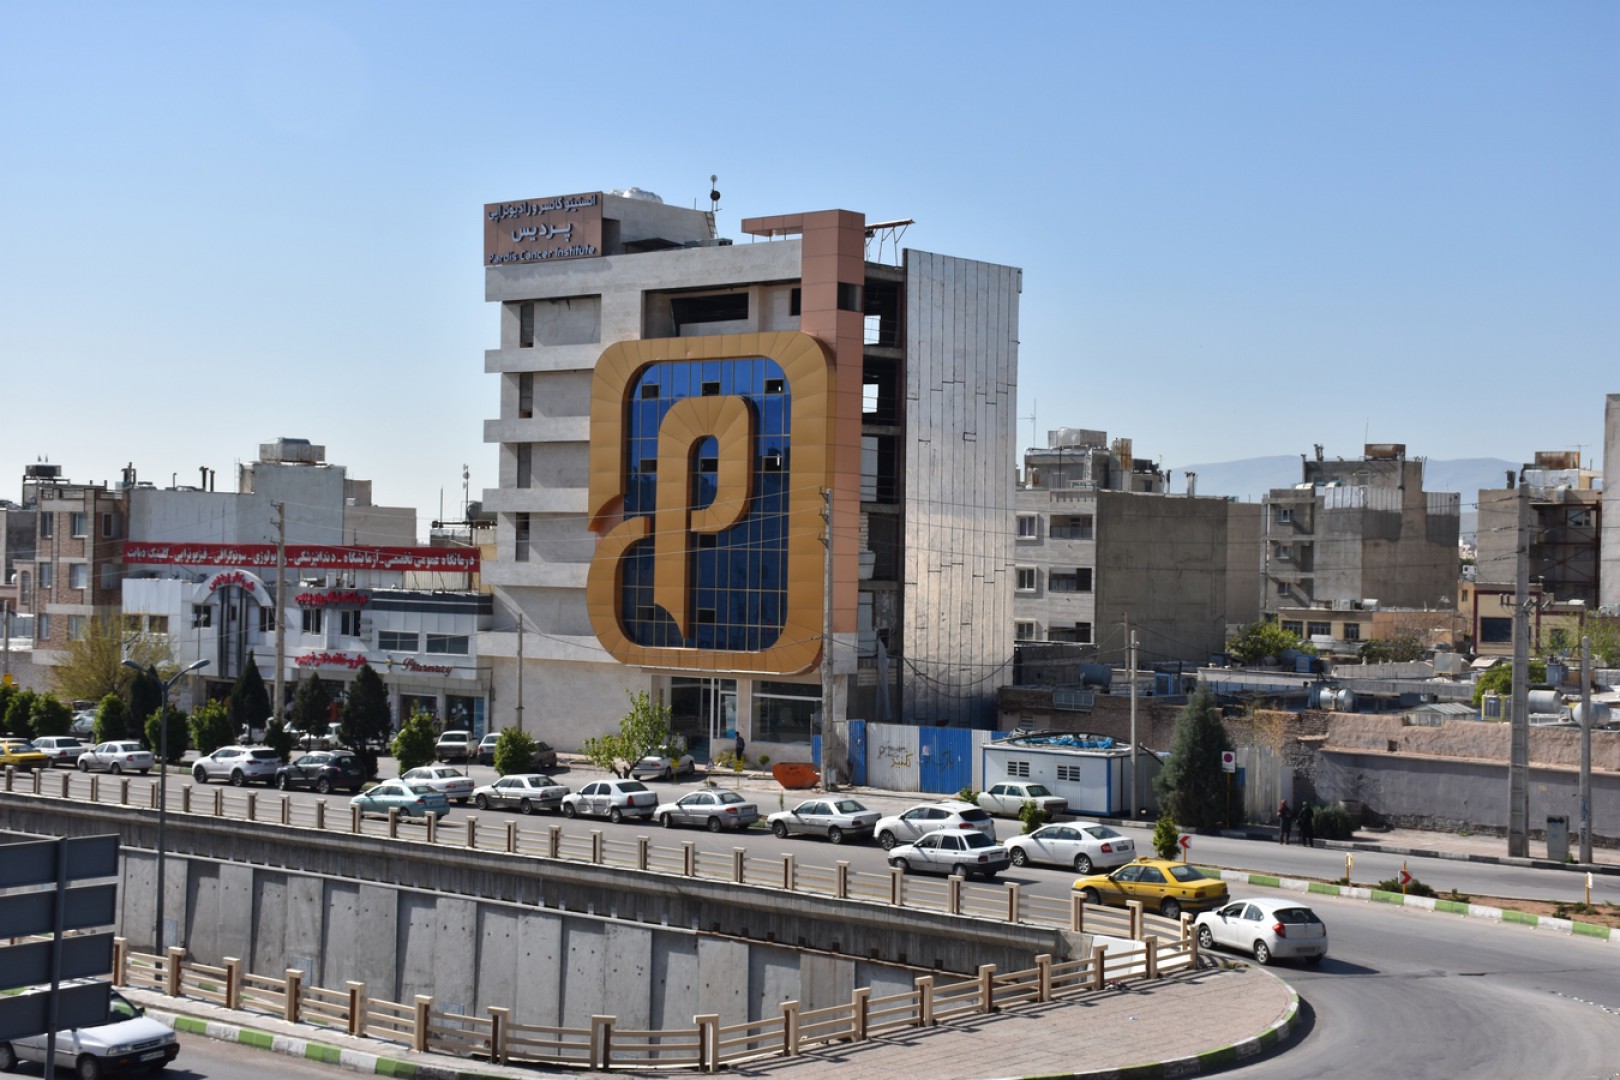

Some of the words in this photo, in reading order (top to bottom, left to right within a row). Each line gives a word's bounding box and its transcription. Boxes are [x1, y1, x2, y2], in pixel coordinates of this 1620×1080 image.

[488, 201, 532, 223] رادیوتراپی
[539, 197, 564, 214] کانسر
[512, 222, 573, 242] پردیس
[489, 251, 519, 263] Pardis
[521, 249, 554, 260] Cancer
[556, 243, 596, 257] Institute
[214, 548, 247, 564] سونوگرافی
[343, 549, 379, 568] آزمایشگاه
[384, 551, 414, 568] تخصصی
[414, 556, 439, 569] عمومی
[440, 553, 475, 569] درمانگاه
[401, 657, 452, 677] Pharmacy
